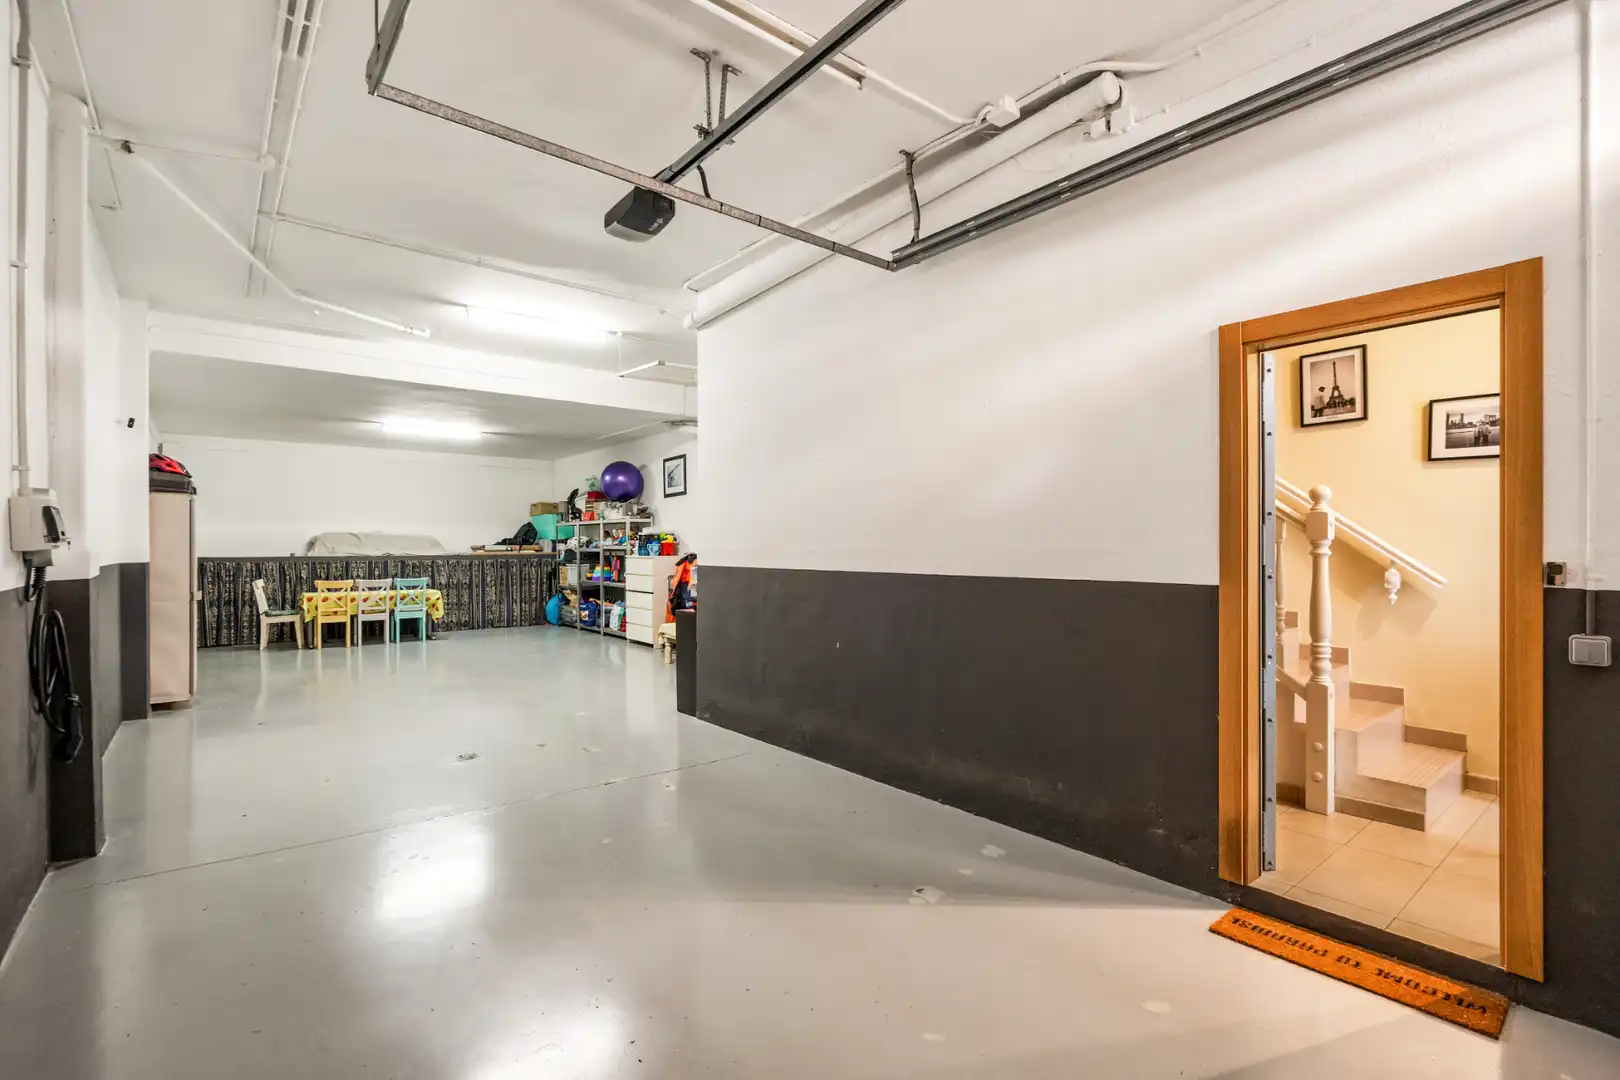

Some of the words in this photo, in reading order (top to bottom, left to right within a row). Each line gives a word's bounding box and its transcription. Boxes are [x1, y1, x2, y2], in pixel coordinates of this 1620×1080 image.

[1231, 916, 1329, 957] PARADISE
[1336, 955, 1361, 970] TO
[1374, 967, 1488, 1015] WELCOME
